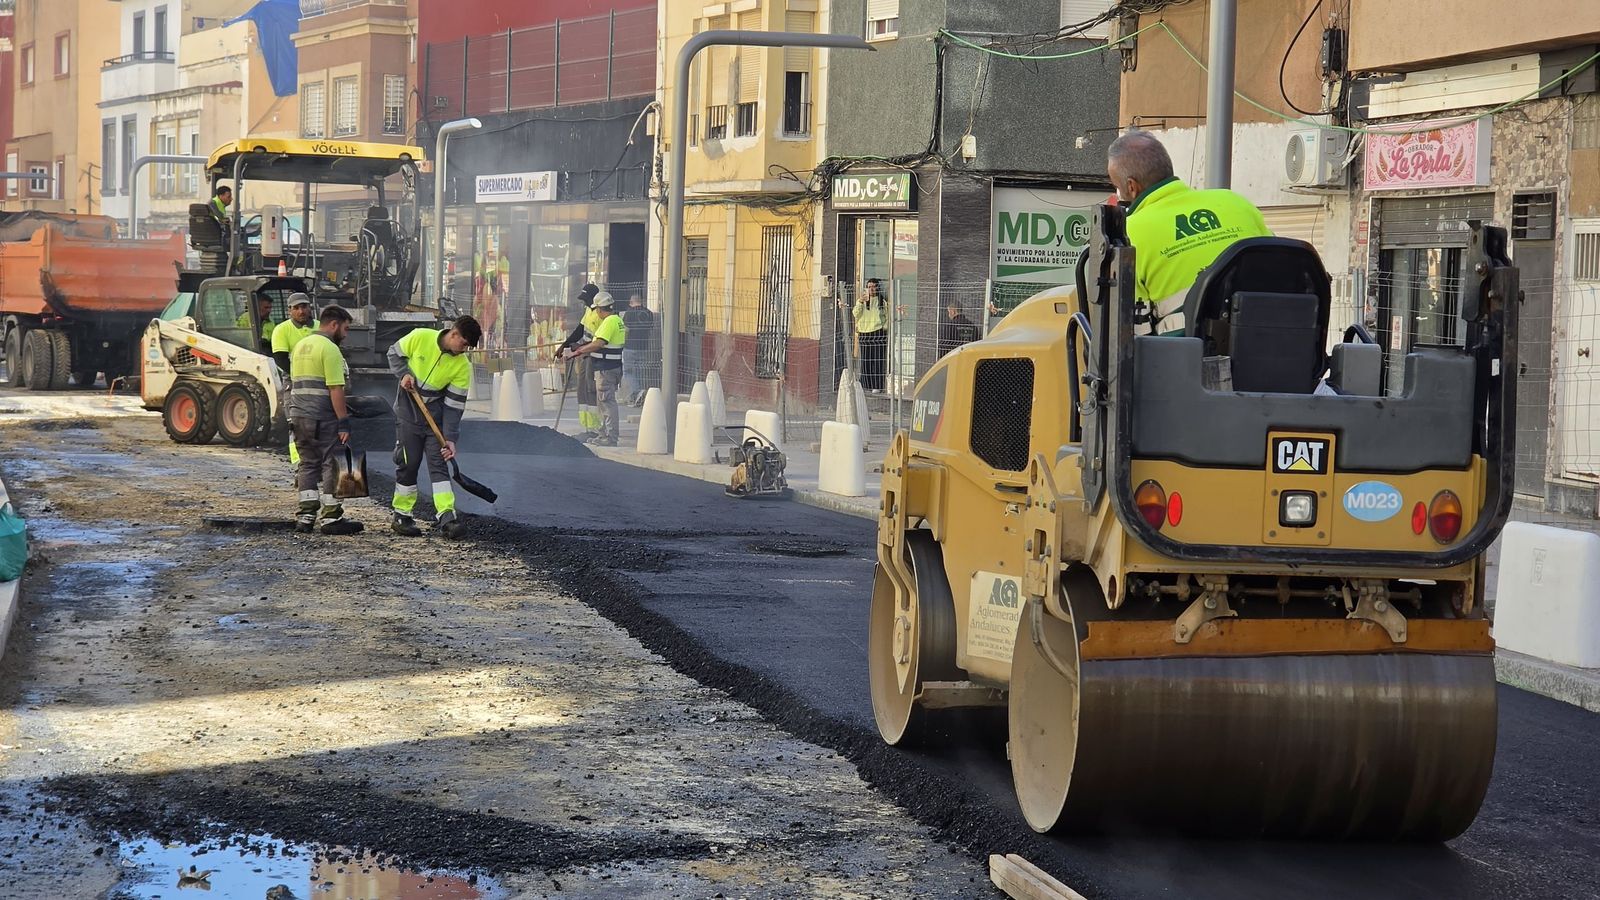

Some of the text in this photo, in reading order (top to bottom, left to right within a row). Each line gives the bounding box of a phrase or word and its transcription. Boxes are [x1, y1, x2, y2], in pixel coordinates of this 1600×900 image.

[1389, 145, 1452, 180] La Perla
[478, 177, 523, 193] SUPERMERCADO
[834, 178, 879, 200] MDyC
[997, 248, 1032, 256] MOVIMIENTO
[1014, 256, 1050, 264] CIUDADANÍA
[913, 399, 928, 432] CAT
[1277, 440, 1324, 471] CAT
[1347, 492, 1399, 509] M023
[977, 605, 1019, 622] Aglomerad
